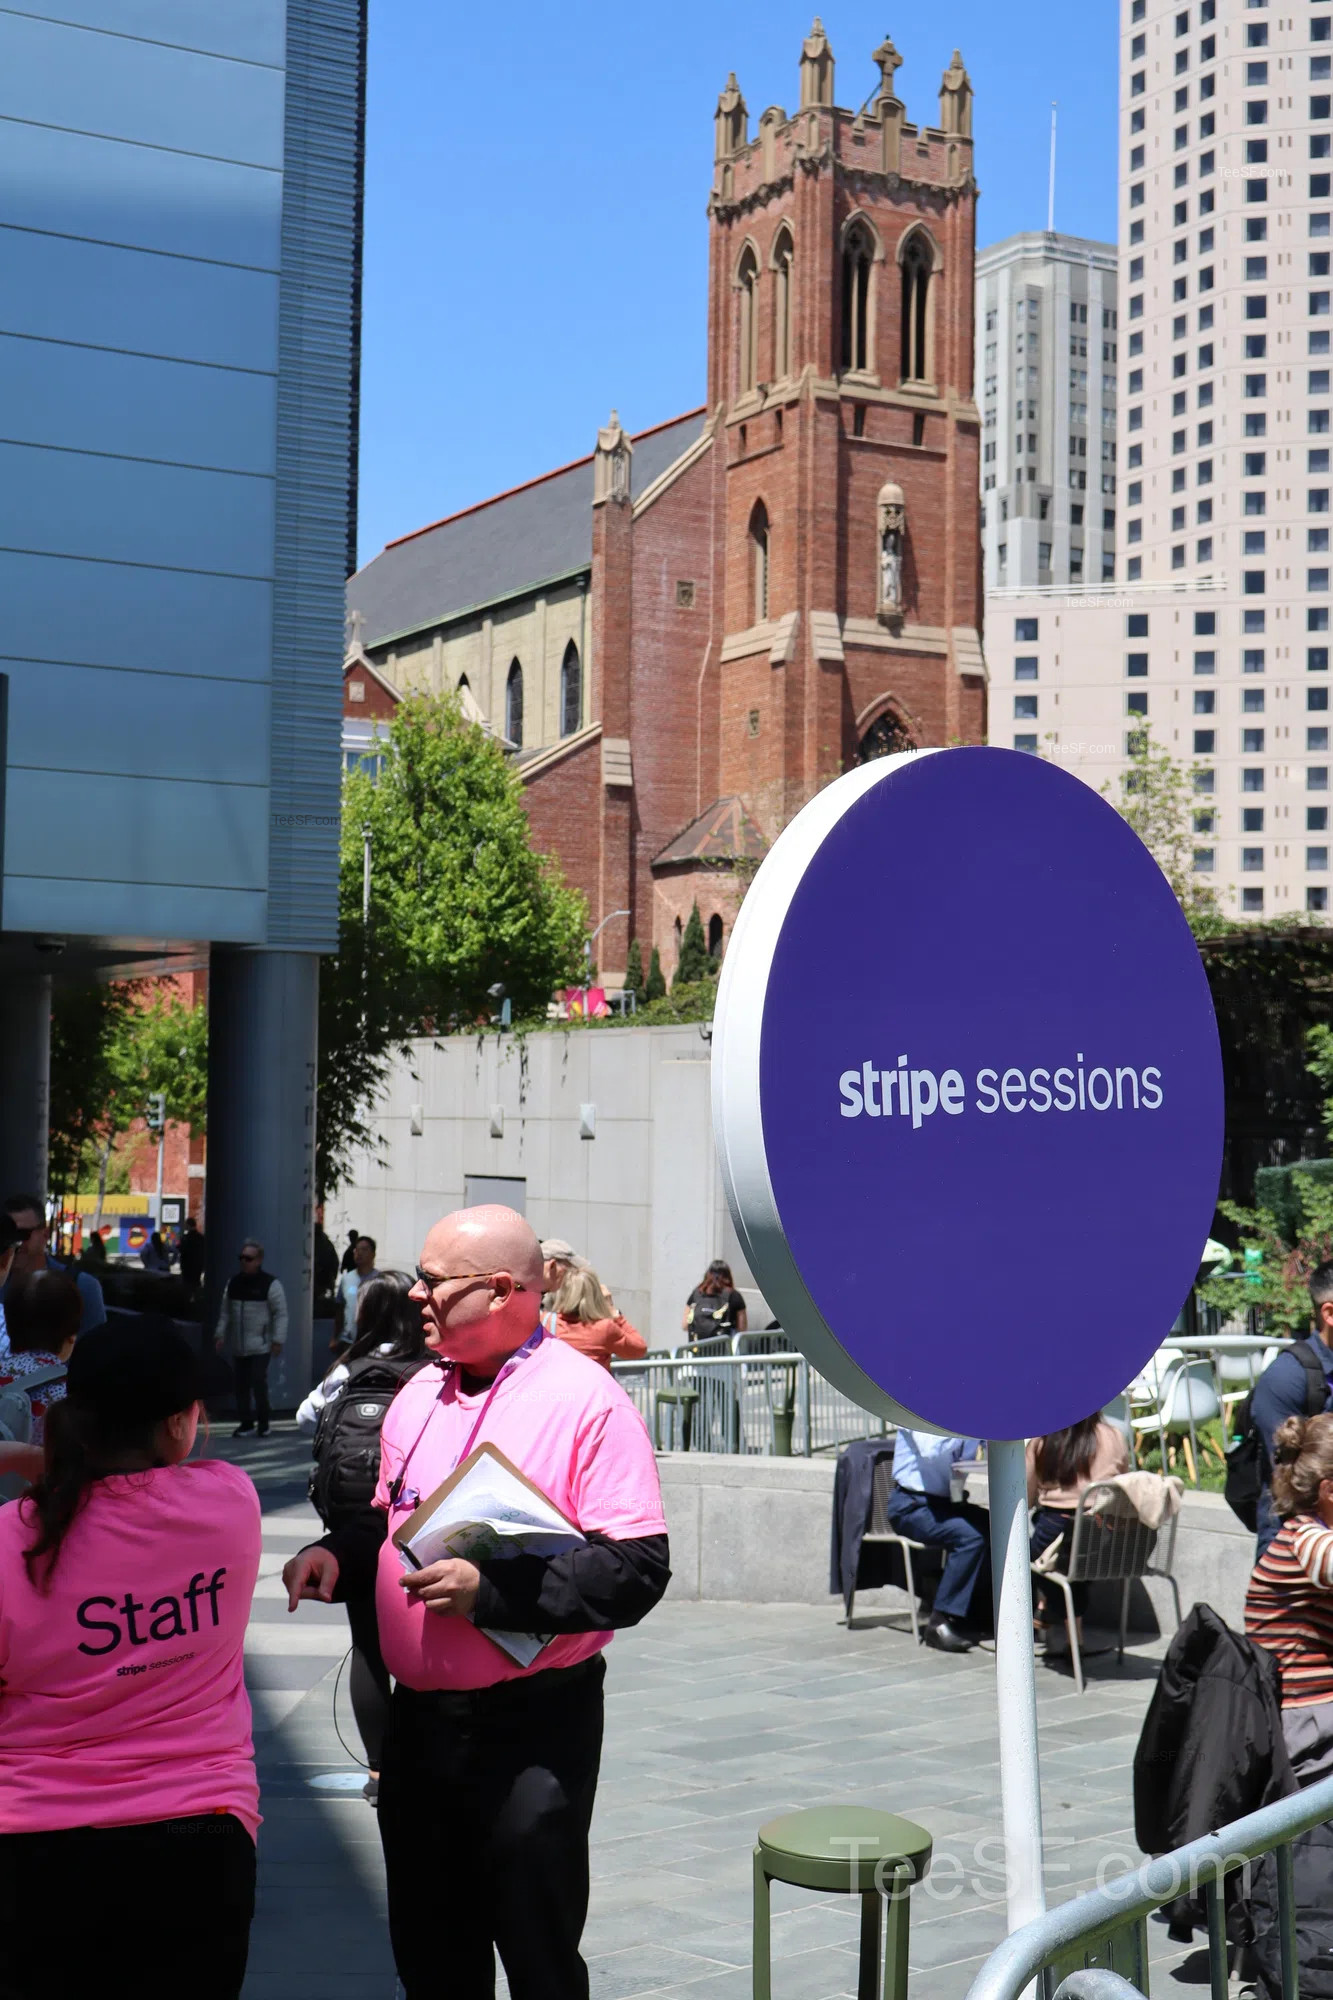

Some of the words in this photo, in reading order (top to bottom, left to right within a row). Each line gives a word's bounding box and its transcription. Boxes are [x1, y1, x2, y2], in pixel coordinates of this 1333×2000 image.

[839, 1054, 966, 1130] stripe
[976, 1053, 1164, 1114] sessions
[76, 1567, 227, 1656] Staff
[116, 1664, 147, 1677] stripe
[148, 1651, 196, 1671] sessions
